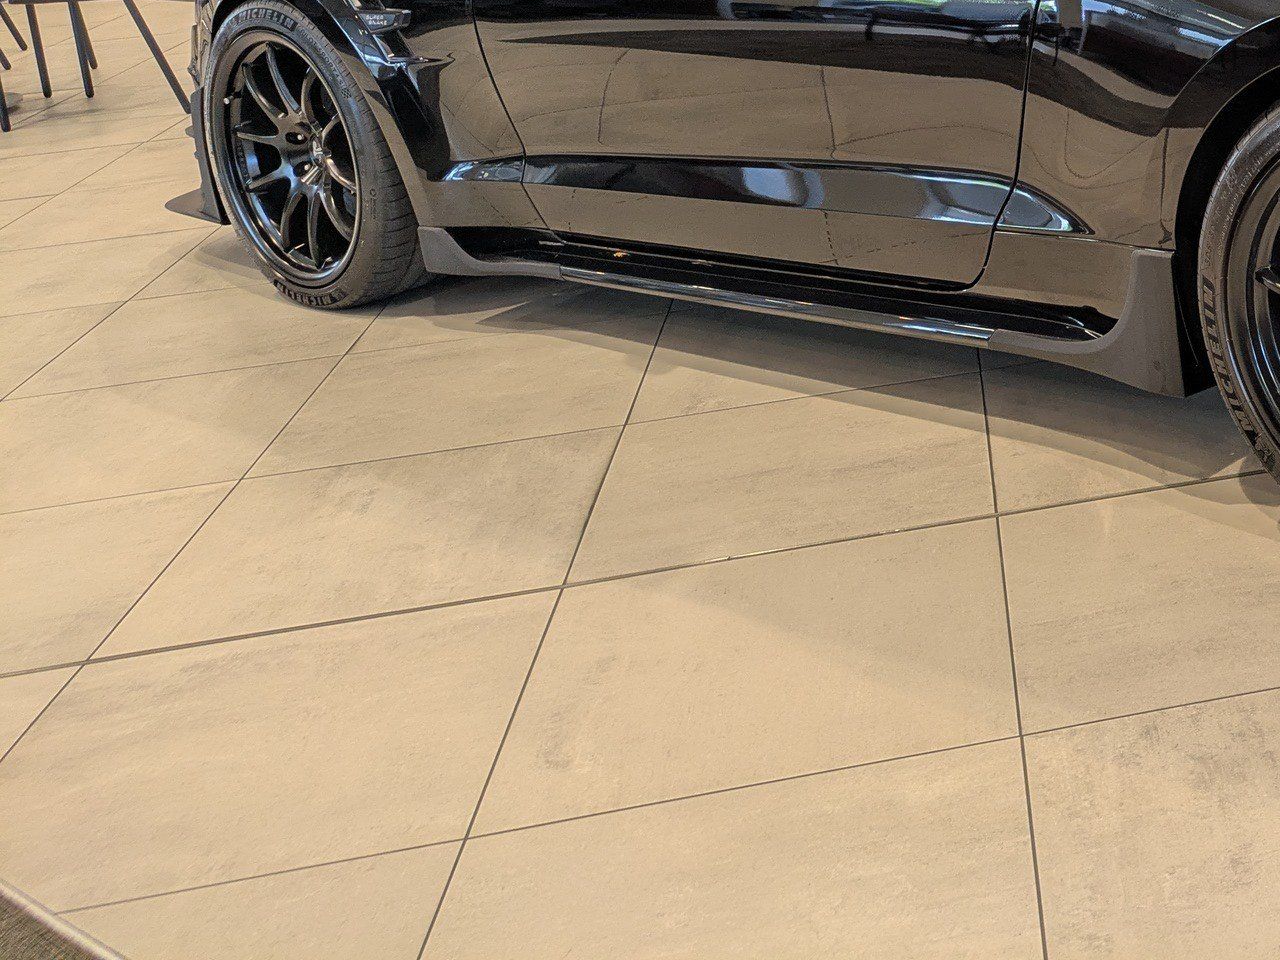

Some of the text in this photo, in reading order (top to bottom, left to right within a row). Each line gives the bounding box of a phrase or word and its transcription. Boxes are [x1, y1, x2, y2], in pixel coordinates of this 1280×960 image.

[239, 8, 296, 31] MICHELIN
[276, 280, 332, 307] MICHELIN
[1202, 280, 1252, 434] MICHELIN
